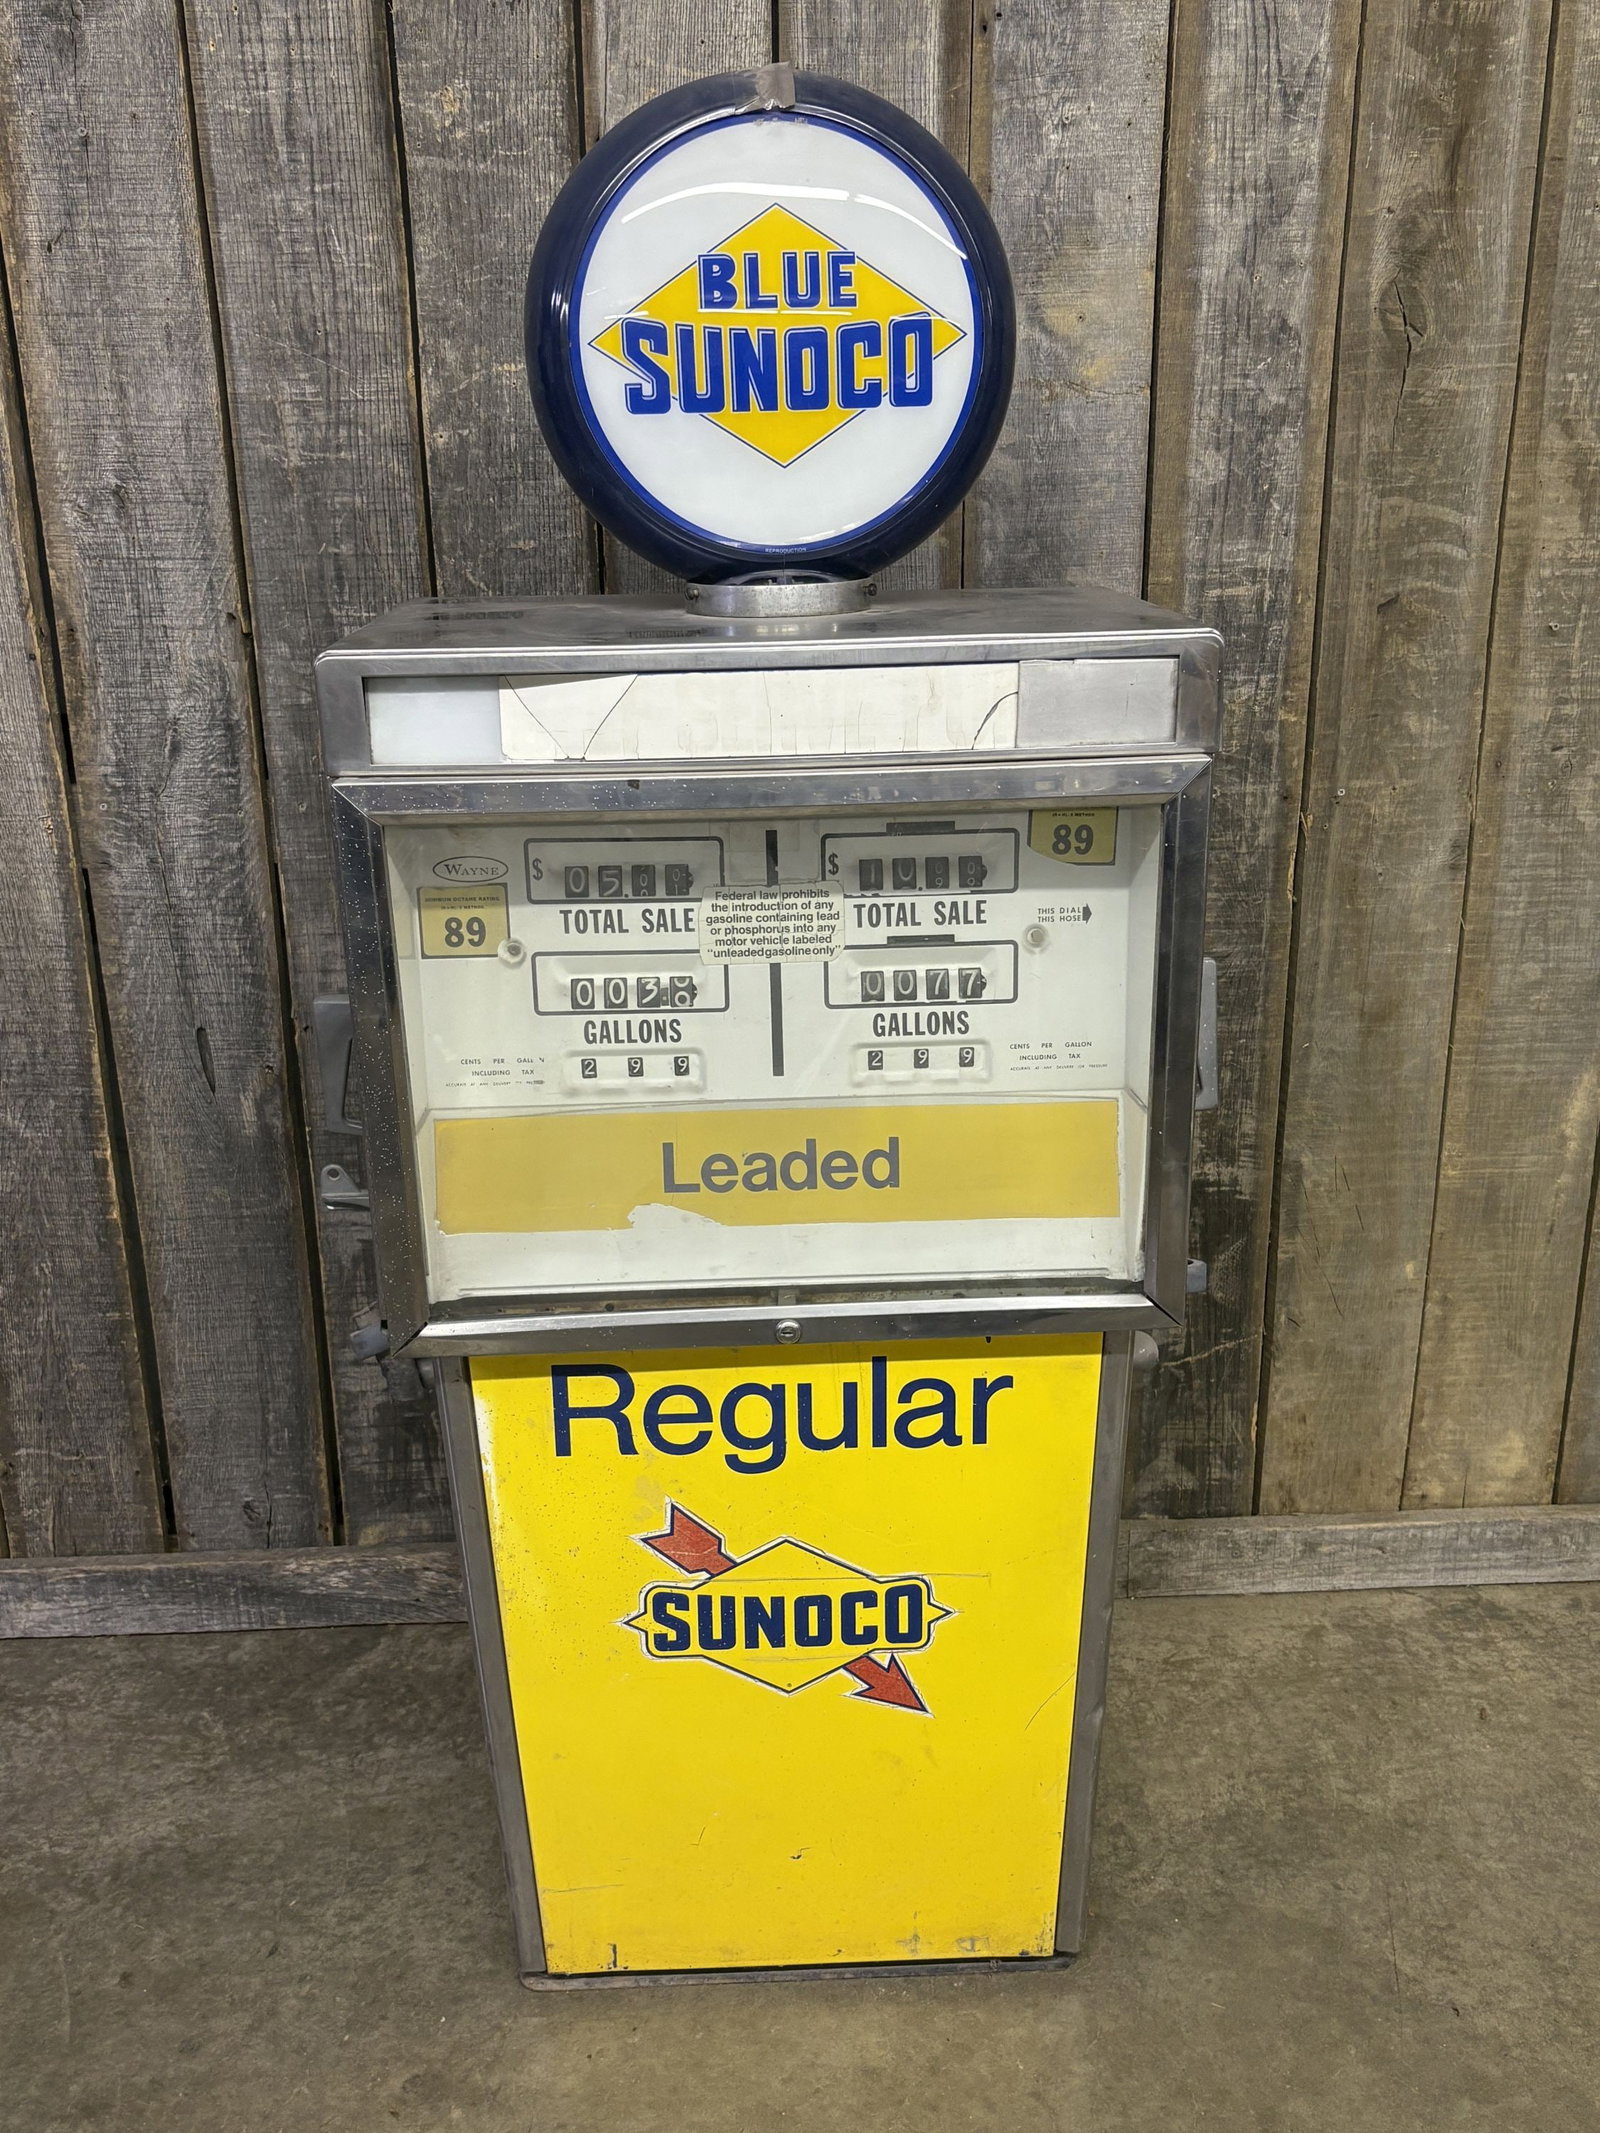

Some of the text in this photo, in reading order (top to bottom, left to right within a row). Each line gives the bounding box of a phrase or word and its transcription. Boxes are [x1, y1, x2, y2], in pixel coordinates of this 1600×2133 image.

[698, 251, 857, 310] BLUE
[621, 311, 933, 415] SUNOCO
[764, 546, 807, 554] REPRODUCTION
[1052, 824, 1094, 855] 89
[532, 858, 544, 880] $
[828, 853, 840, 875] $
[711, 900, 834, 912] the introduction of any
[715, 889, 830, 902] Federal law prohibits
[559, 908, 695, 934] TOTAL SALE
[705, 911, 840, 926] gasoline containing lead
[853, 900, 987, 928] TOTAL SALE
[1038, 906, 1081, 915] THIS DIAL
[1038, 914, 1081, 923] THIS HOSE
[444, 916, 486, 948] 89
[710, 923, 837, 938] or phosphorus into any
[715, 934, 832, 947] motor vehicle labeled
[584, 1019, 682, 1044] GALLONS
[873, 1011, 970, 1037] GALLONS
[662, 1137, 900, 1193] Leaded
[550, 1356, 1014, 1474] Regular
[652, 1584, 923, 1651] SUNOCO
